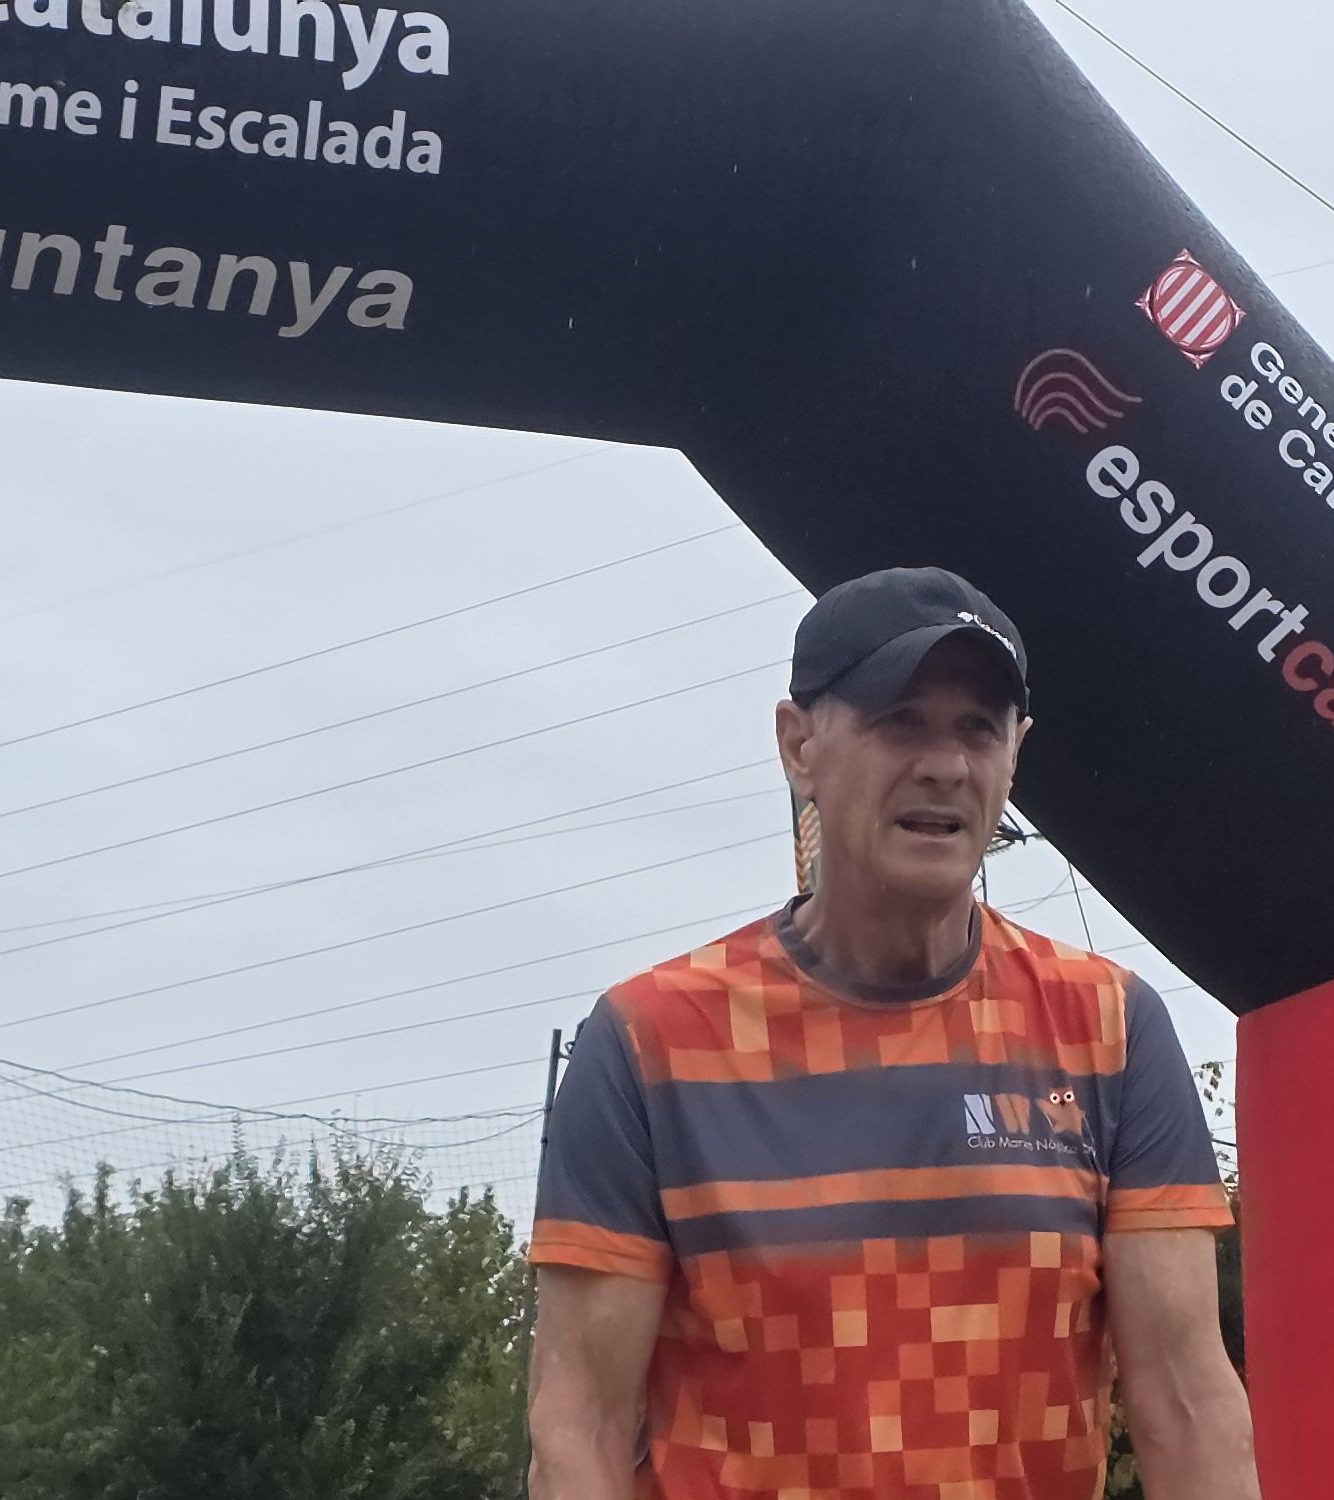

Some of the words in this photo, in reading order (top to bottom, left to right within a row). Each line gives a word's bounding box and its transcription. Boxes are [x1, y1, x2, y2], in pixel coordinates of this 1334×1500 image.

[119, 79, 139, 140] i
[155, 85, 443, 175] Escalada
[1220, 374, 1273, 431] de
